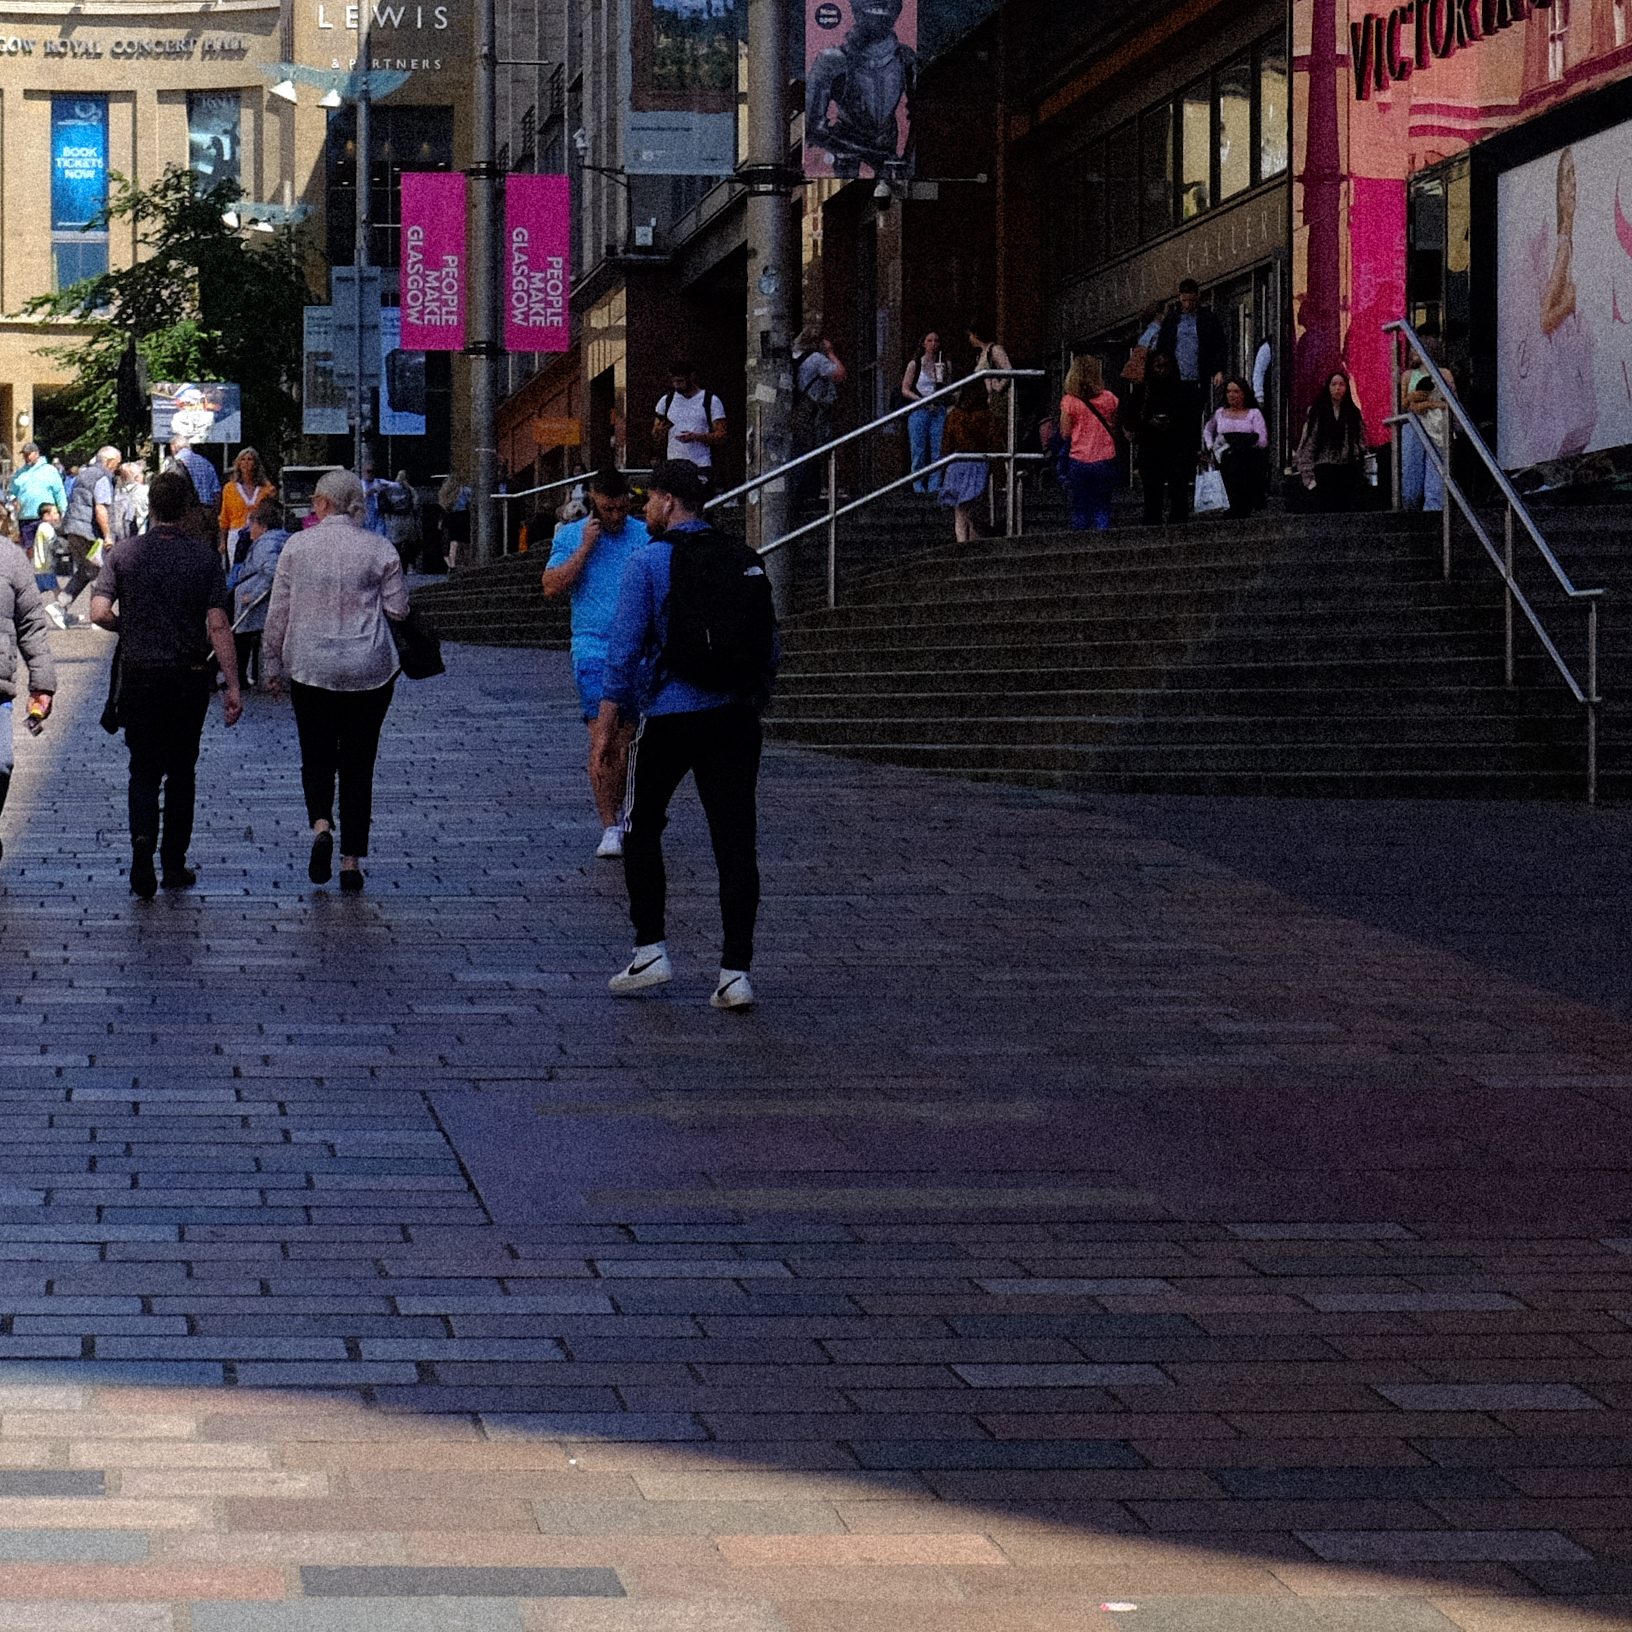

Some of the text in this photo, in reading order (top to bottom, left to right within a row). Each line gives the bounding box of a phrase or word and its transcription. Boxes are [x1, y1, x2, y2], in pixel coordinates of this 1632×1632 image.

[318, 5, 449, 29] LEWIS
[43, 38, 103, 59] ROYAL
[110, 37, 197, 60] CONCERT
[349, 58, 443, 70] PRTNERS
[55, 157, 104, 170] TICKETS
[62, 145, 98, 158] BOOK
[64, 168, 96, 180] NOW
[407, 225, 424, 326] GLASGOW
[441, 255, 458, 327] PEOPLE
[512, 226, 529, 327] GLASGOW
[546, 256, 563, 328] PEOPLE
[424, 269, 441, 326] MAKE
[529, 271, 545, 328] MAKE
